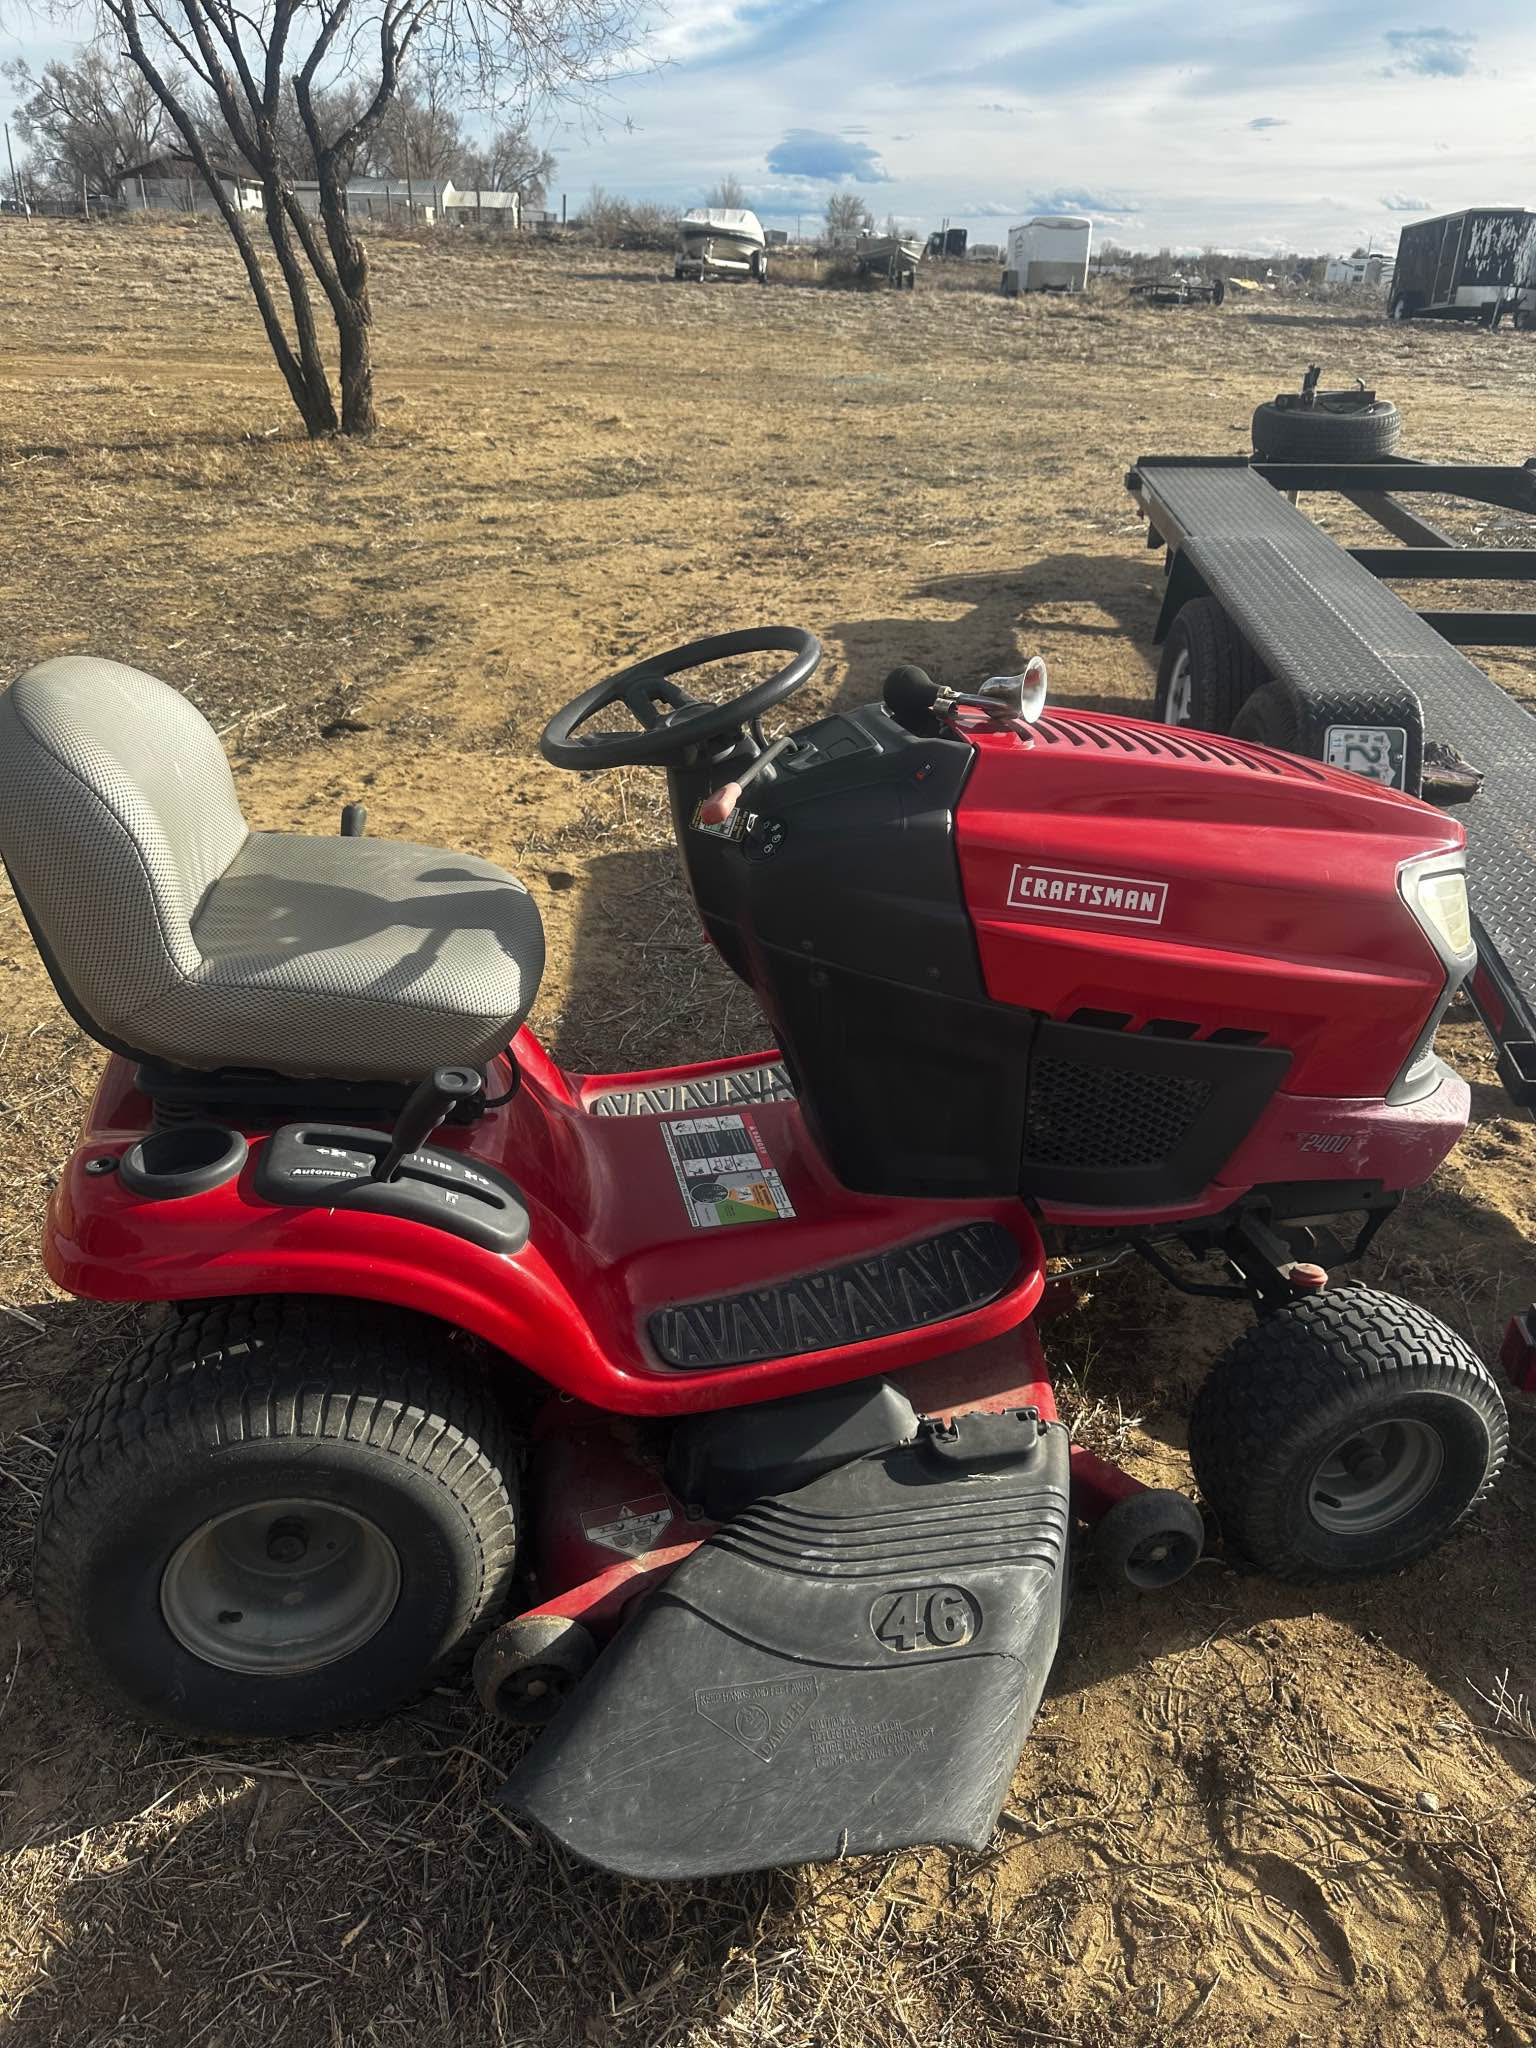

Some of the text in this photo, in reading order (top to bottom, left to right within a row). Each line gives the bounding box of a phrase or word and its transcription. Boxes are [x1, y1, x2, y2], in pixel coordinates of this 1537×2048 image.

[1020, 876, 1157, 912] CRAFTSMAN
[1300, 1134, 1352, 1153] 2400
[291, 1167, 358, 1179] Automatic
[876, 1588, 976, 1652] 46
[751, 1687, 769, 1699] AND
[790, 1679, 813, 1697] AWAY
[759, 1701, 806, 1758] DANGER
